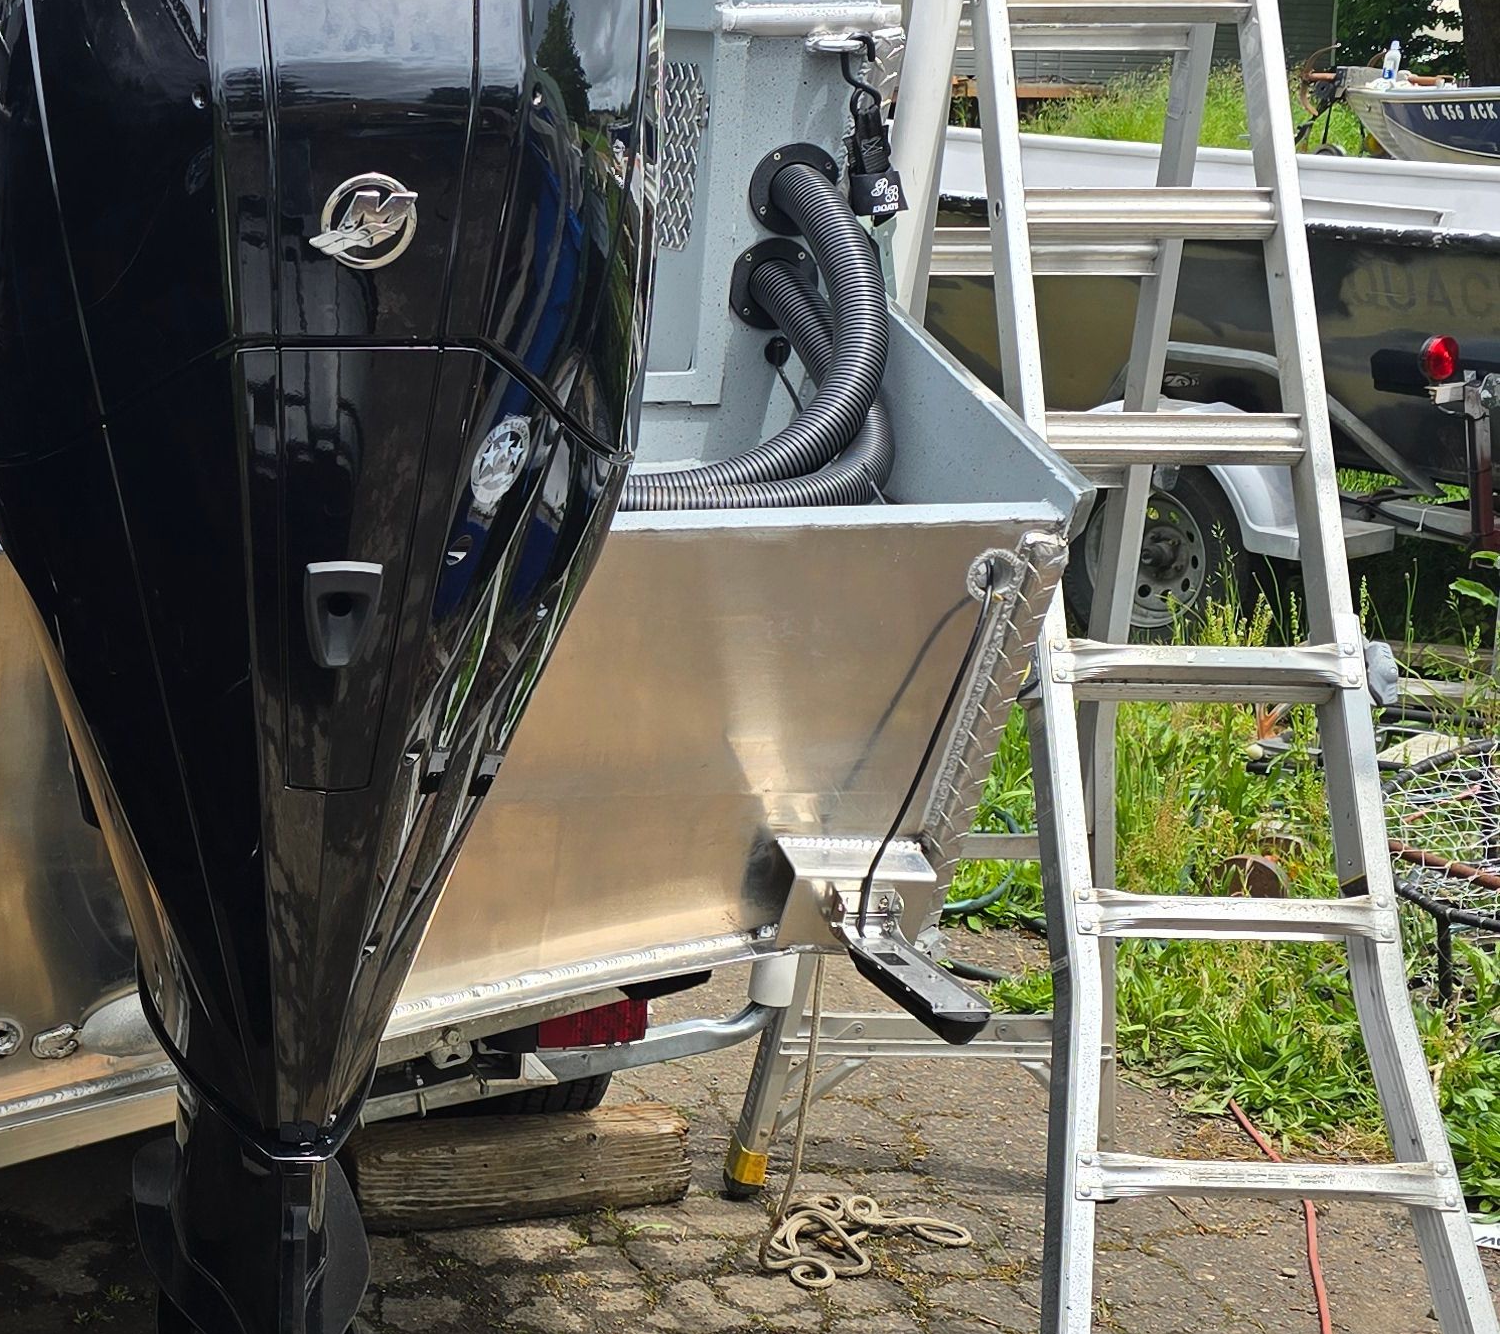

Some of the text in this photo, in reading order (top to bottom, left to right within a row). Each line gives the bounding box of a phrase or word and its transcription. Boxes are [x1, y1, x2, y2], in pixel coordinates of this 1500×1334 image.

[1422, 104, 1440, 121] OR
[1441, 104, 1465, 121] 456
[1352, 264, 1500, 318] QUAC
